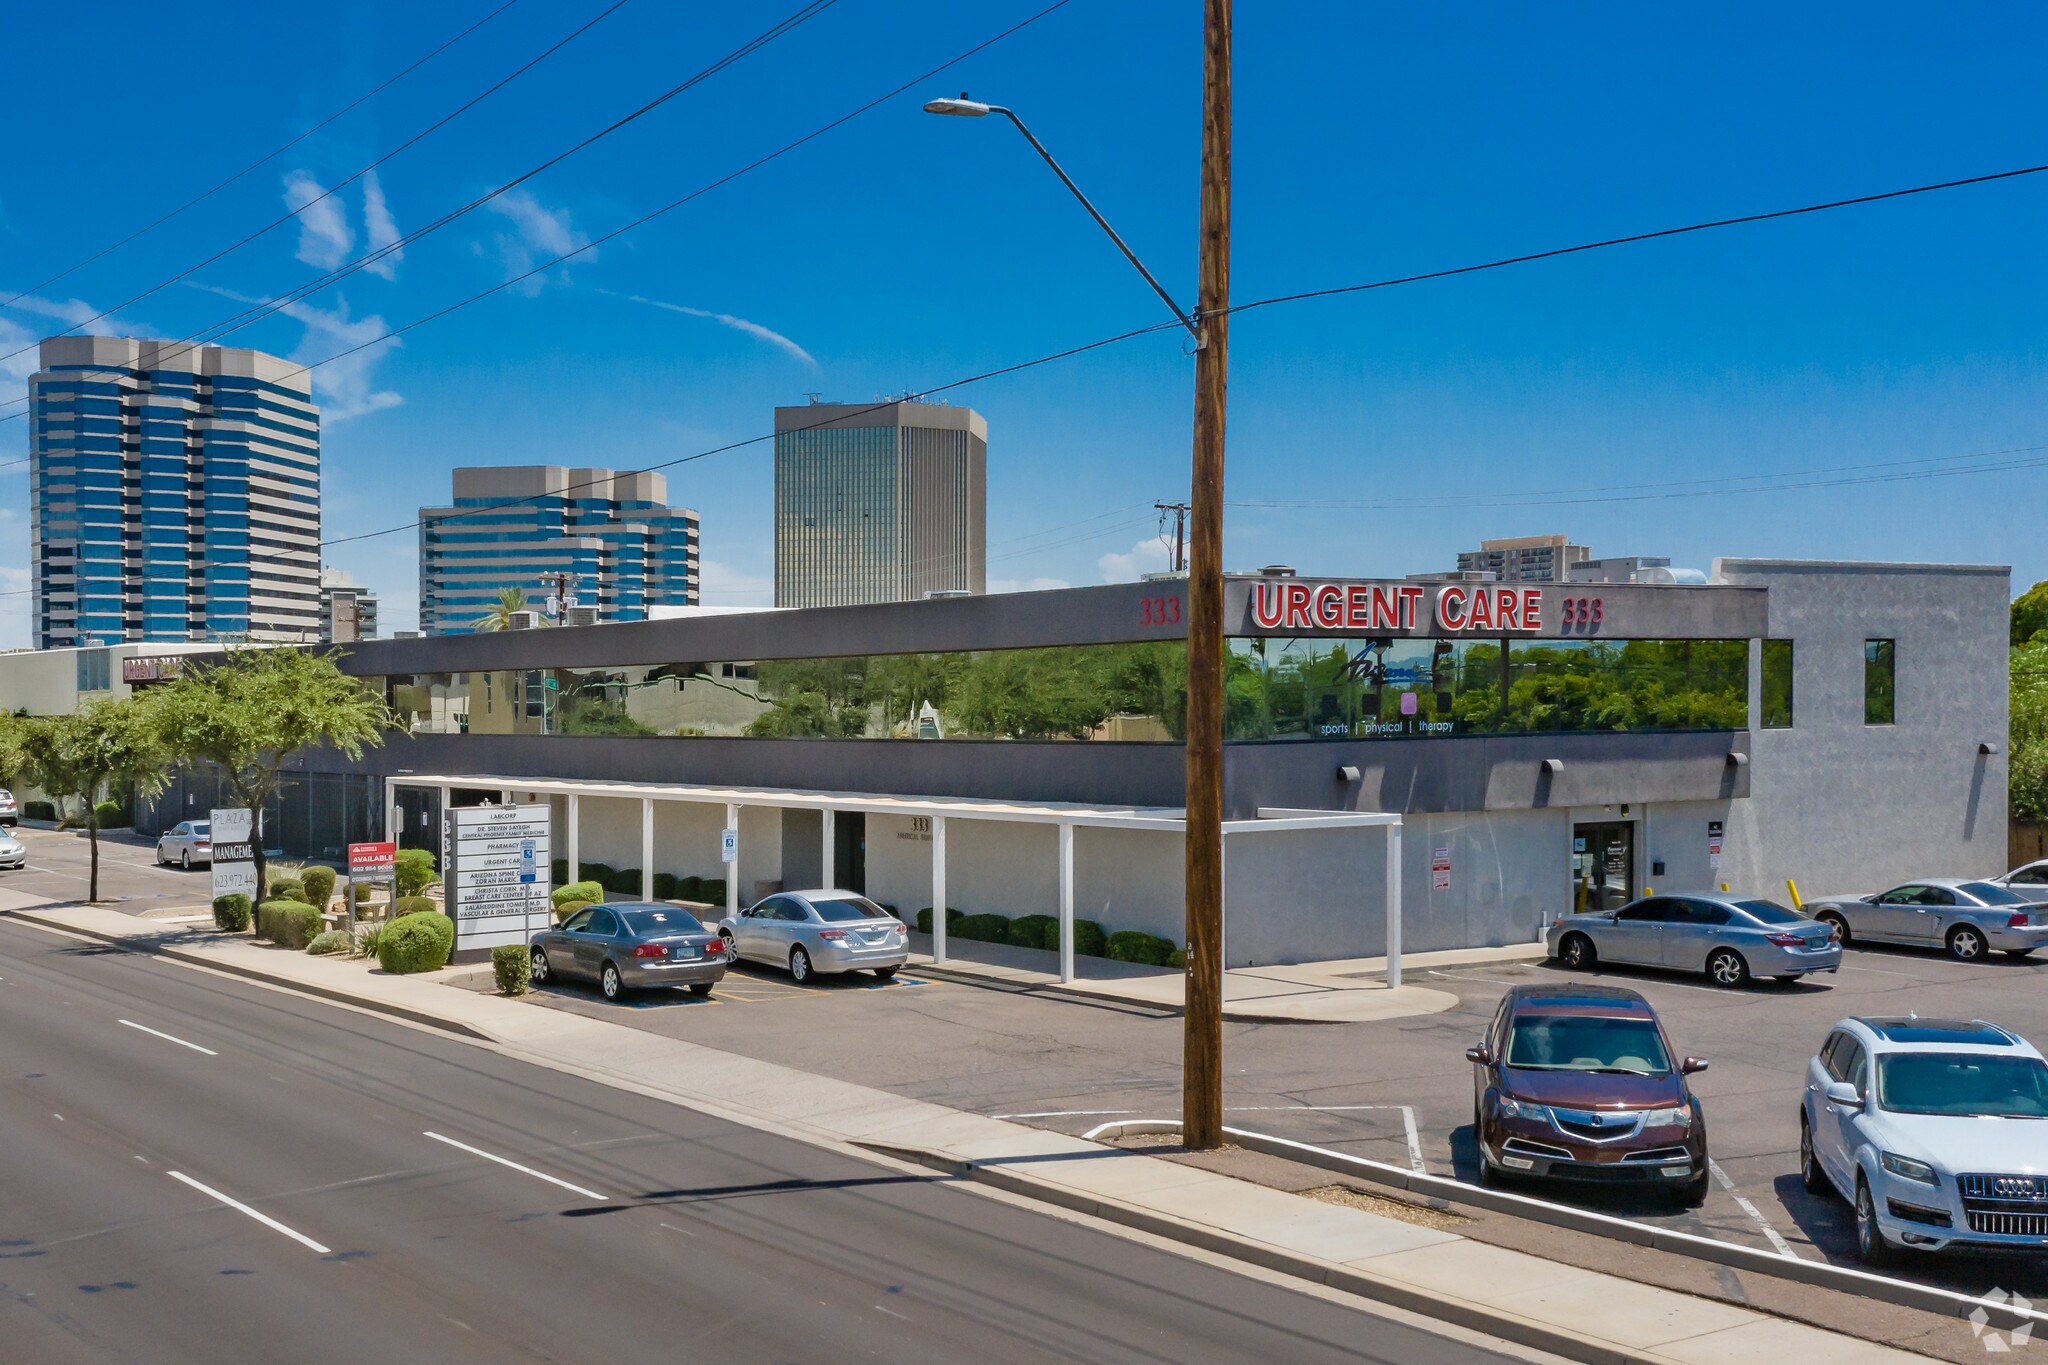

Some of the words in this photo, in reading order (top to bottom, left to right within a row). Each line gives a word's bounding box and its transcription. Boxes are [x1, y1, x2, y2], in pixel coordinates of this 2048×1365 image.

[1139, 596, 1181, 628] 333
[1252, 584, 1424, 629] URGENT
[1436, 586, 1542, 631] CARE
[1562, 597, 1604, 625] 333
[1321, 723, 1348, 736] sports
[1365, 721, 1403, 735] physical
[1419, 720, 1454, 733] therapy
[213, 813, 245, 825] PLAZA
[911, 817, 928, 832] 333
[214, 844, 254, 860] MANAGEME
[352, 854, 394, 863] AVAILABLE
[484, 858, 507, 866] URGENT
[460, 909, 490, 917] VASCULAR
[465, 902, 505, 911] SALAHEDDINE
[1187, 942, 1192, 950] 2
